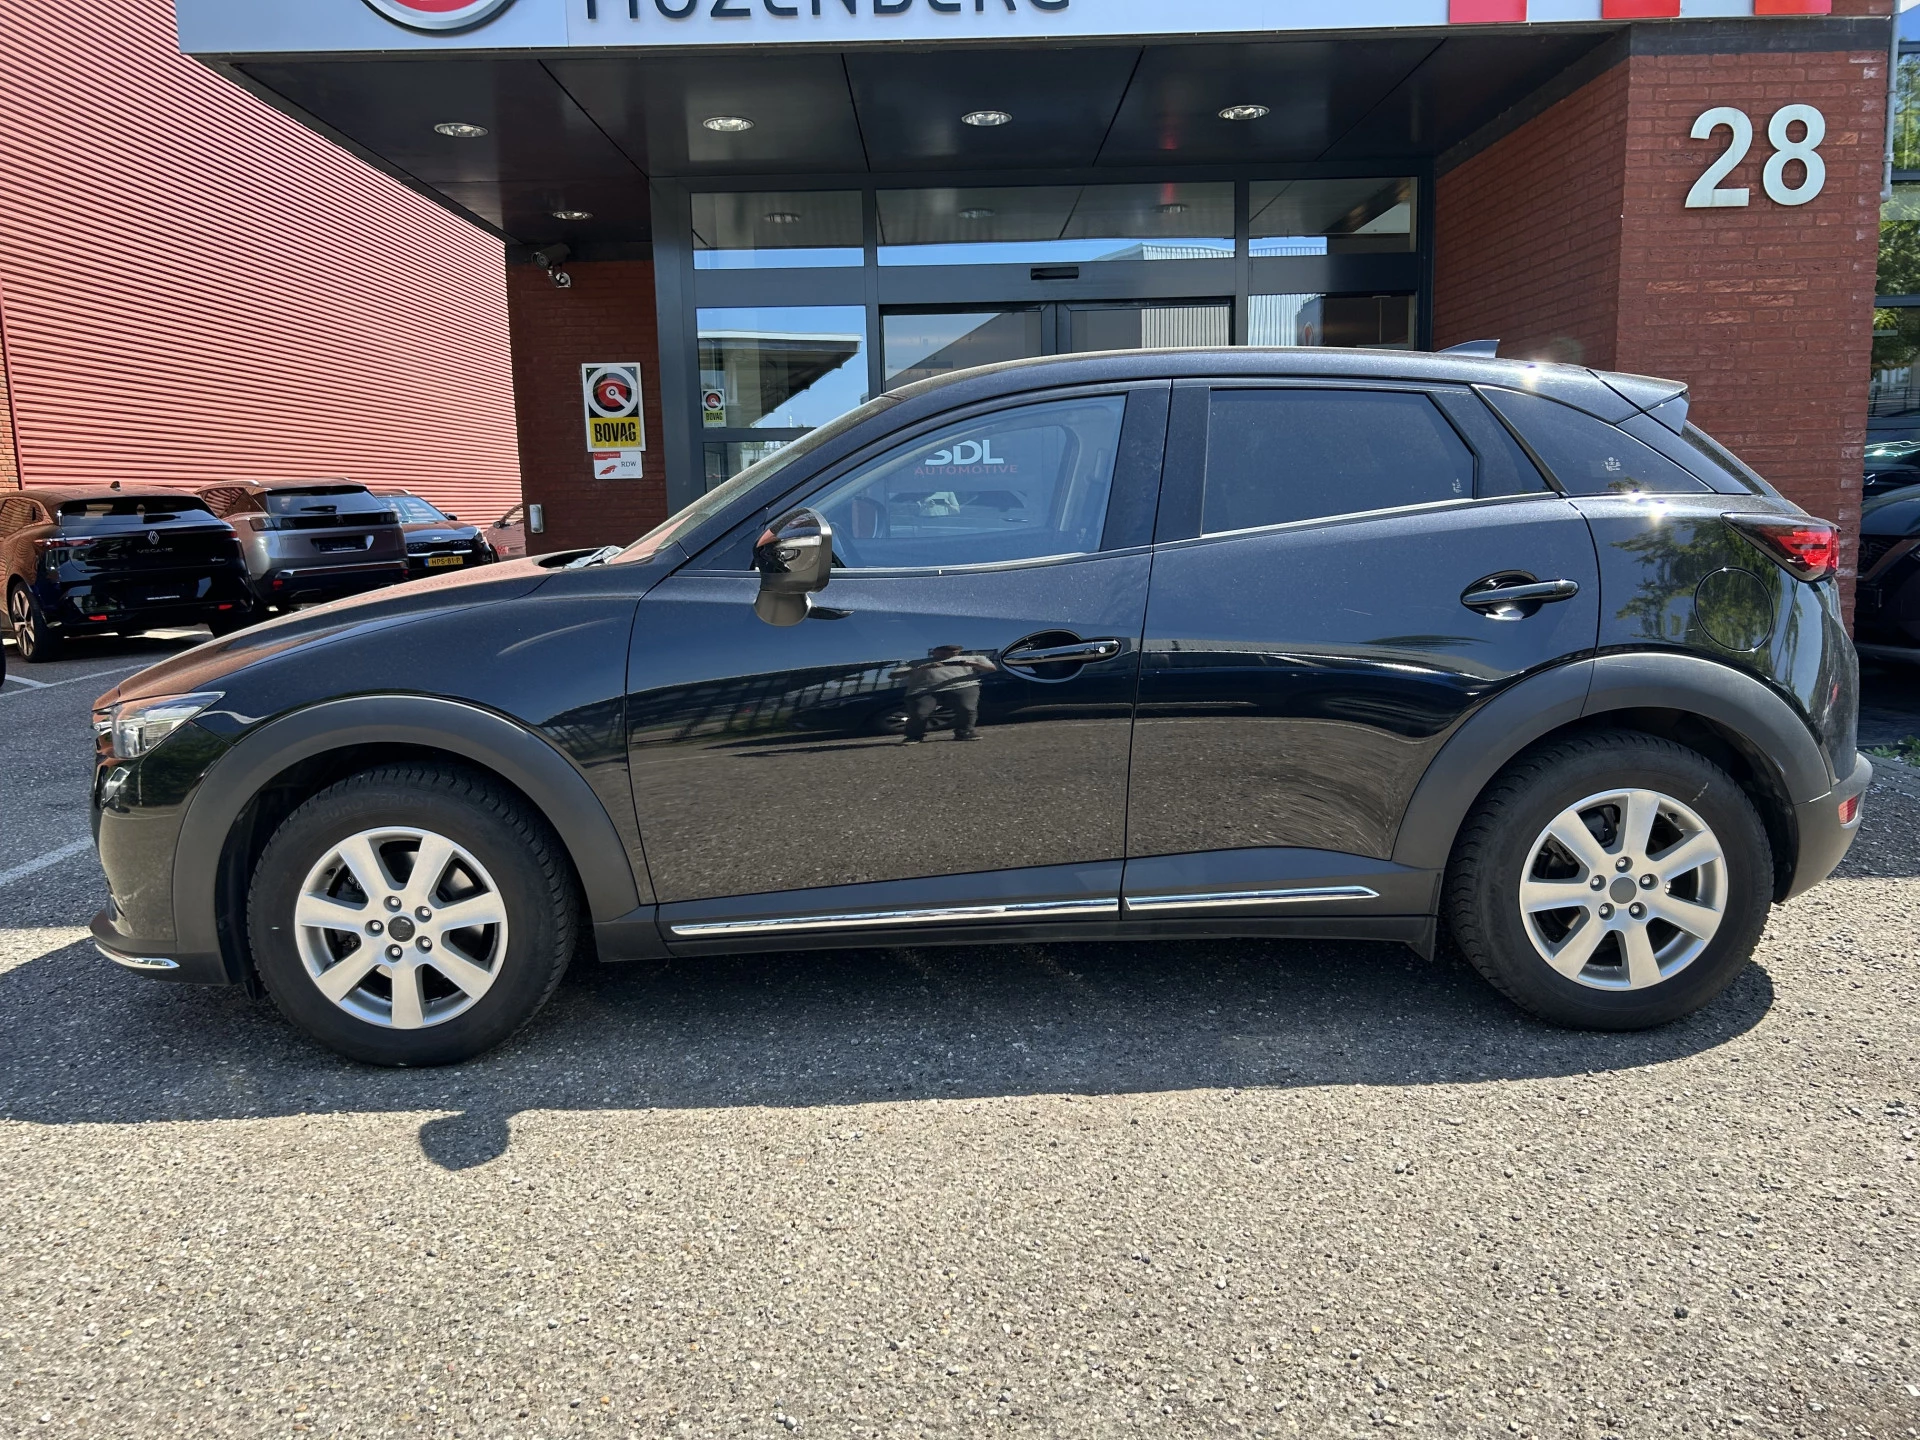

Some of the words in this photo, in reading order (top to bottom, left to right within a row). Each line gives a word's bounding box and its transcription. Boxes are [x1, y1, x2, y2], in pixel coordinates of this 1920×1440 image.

[1685, 104, 1826, 208] 28
[706, 412, 722, 421] BOVAG
[594, 422, 636, 442] BOVAG
[924, 439, 1004, 465] SDL
[914, 465, 1017, 475] AUTOMOTIVE
